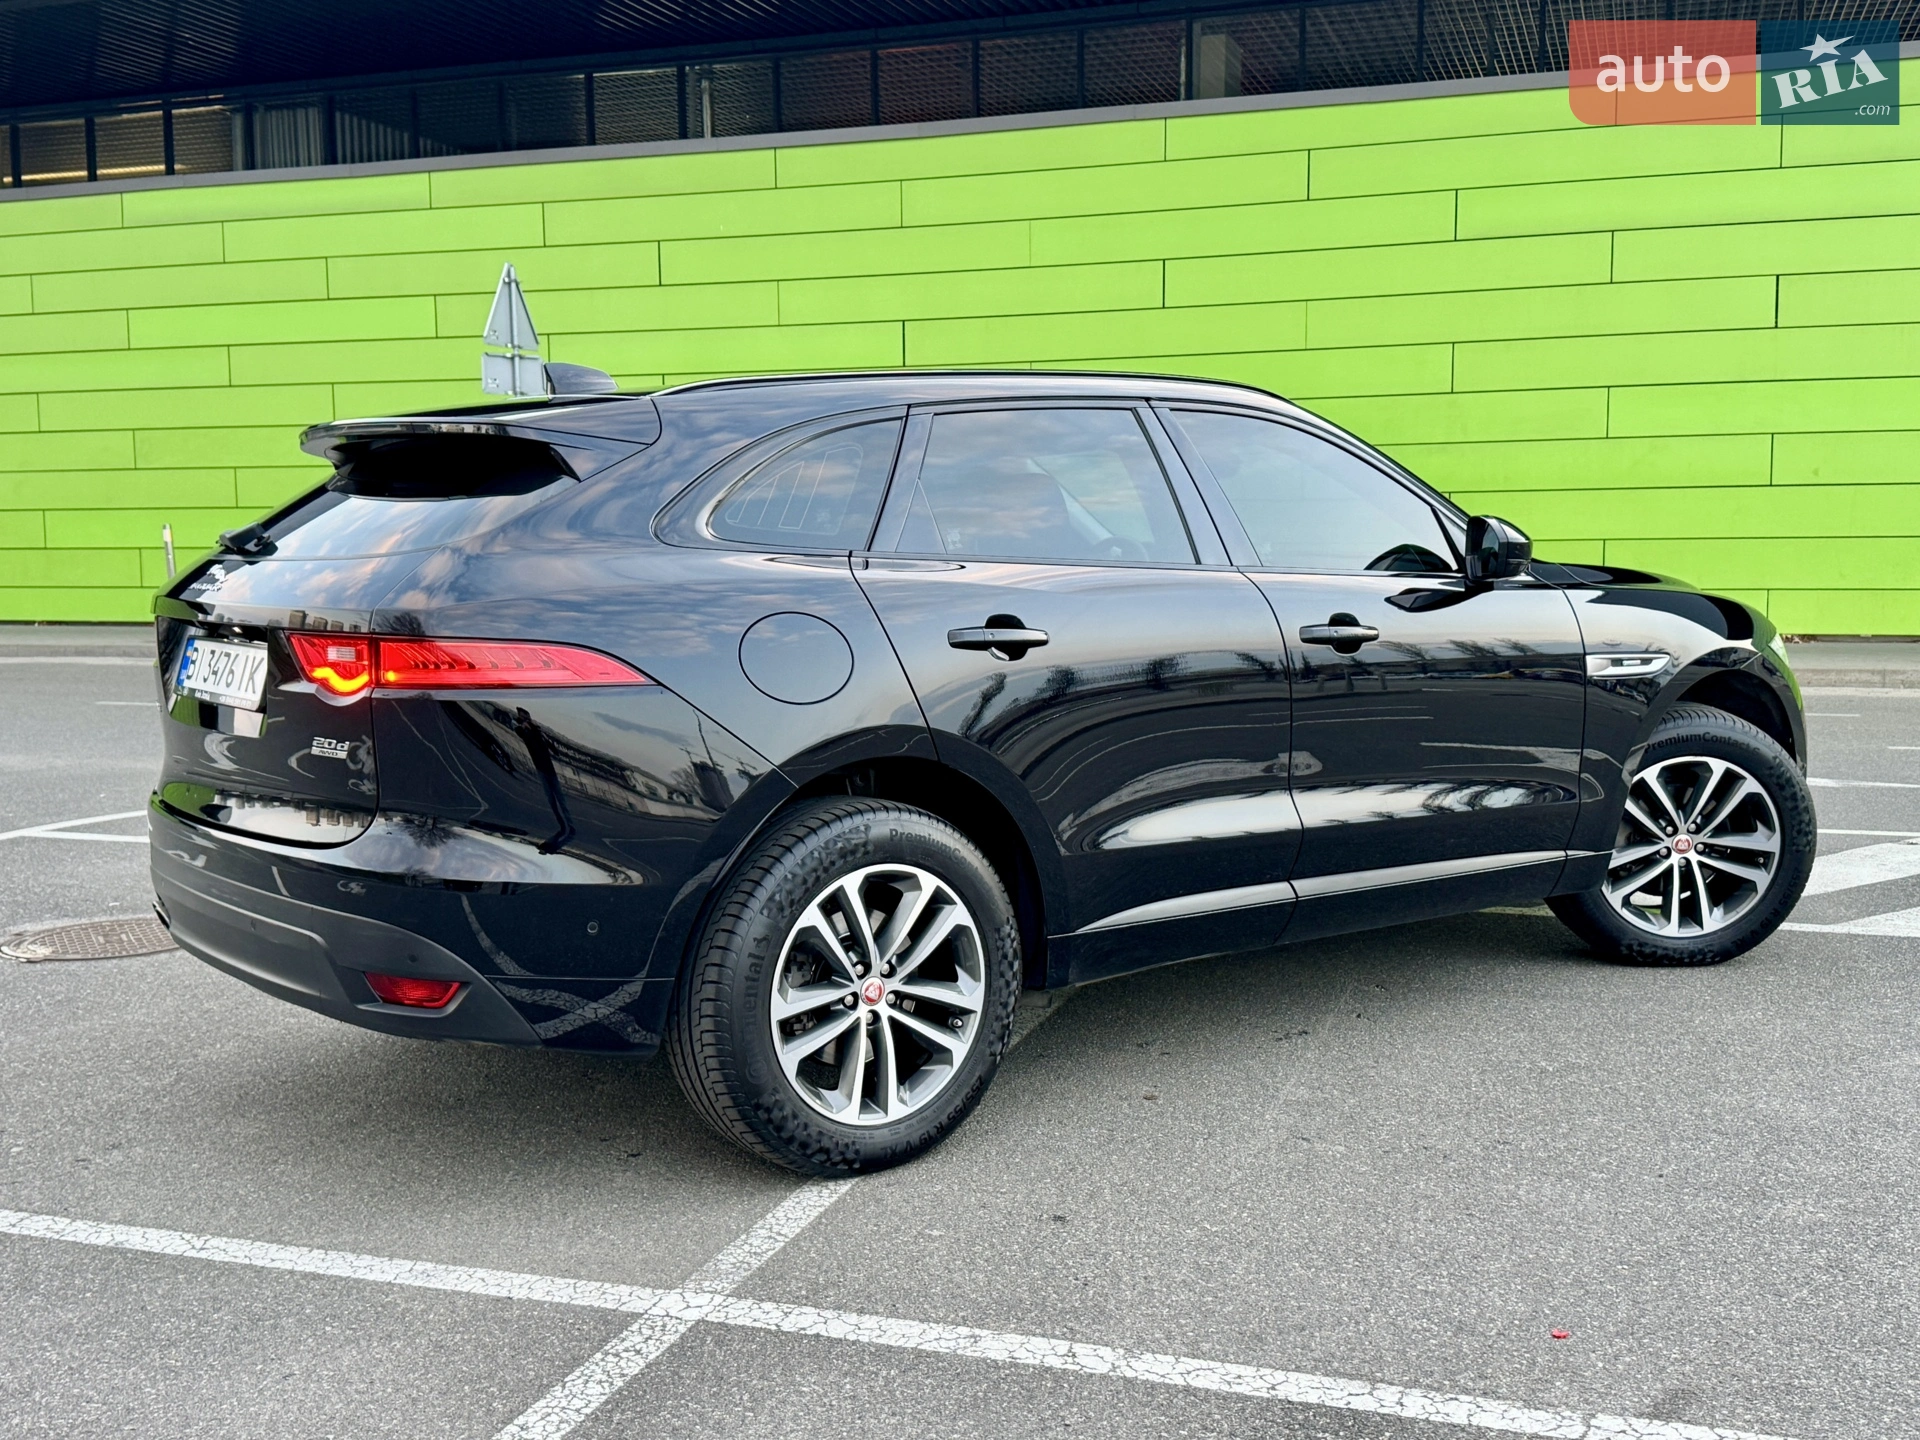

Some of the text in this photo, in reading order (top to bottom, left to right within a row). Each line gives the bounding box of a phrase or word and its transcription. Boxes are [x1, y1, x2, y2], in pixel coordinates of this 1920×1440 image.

[188, 582, 222, 592] AGUAR
[312, 736, 350, 751] 20d
[1644, 731, 1751, 754] PremiumContact
[743, 951, 768, 1084] Conental
[933, 1120, 946, 1135] R
[917, 1129, 934, 1149] 19
